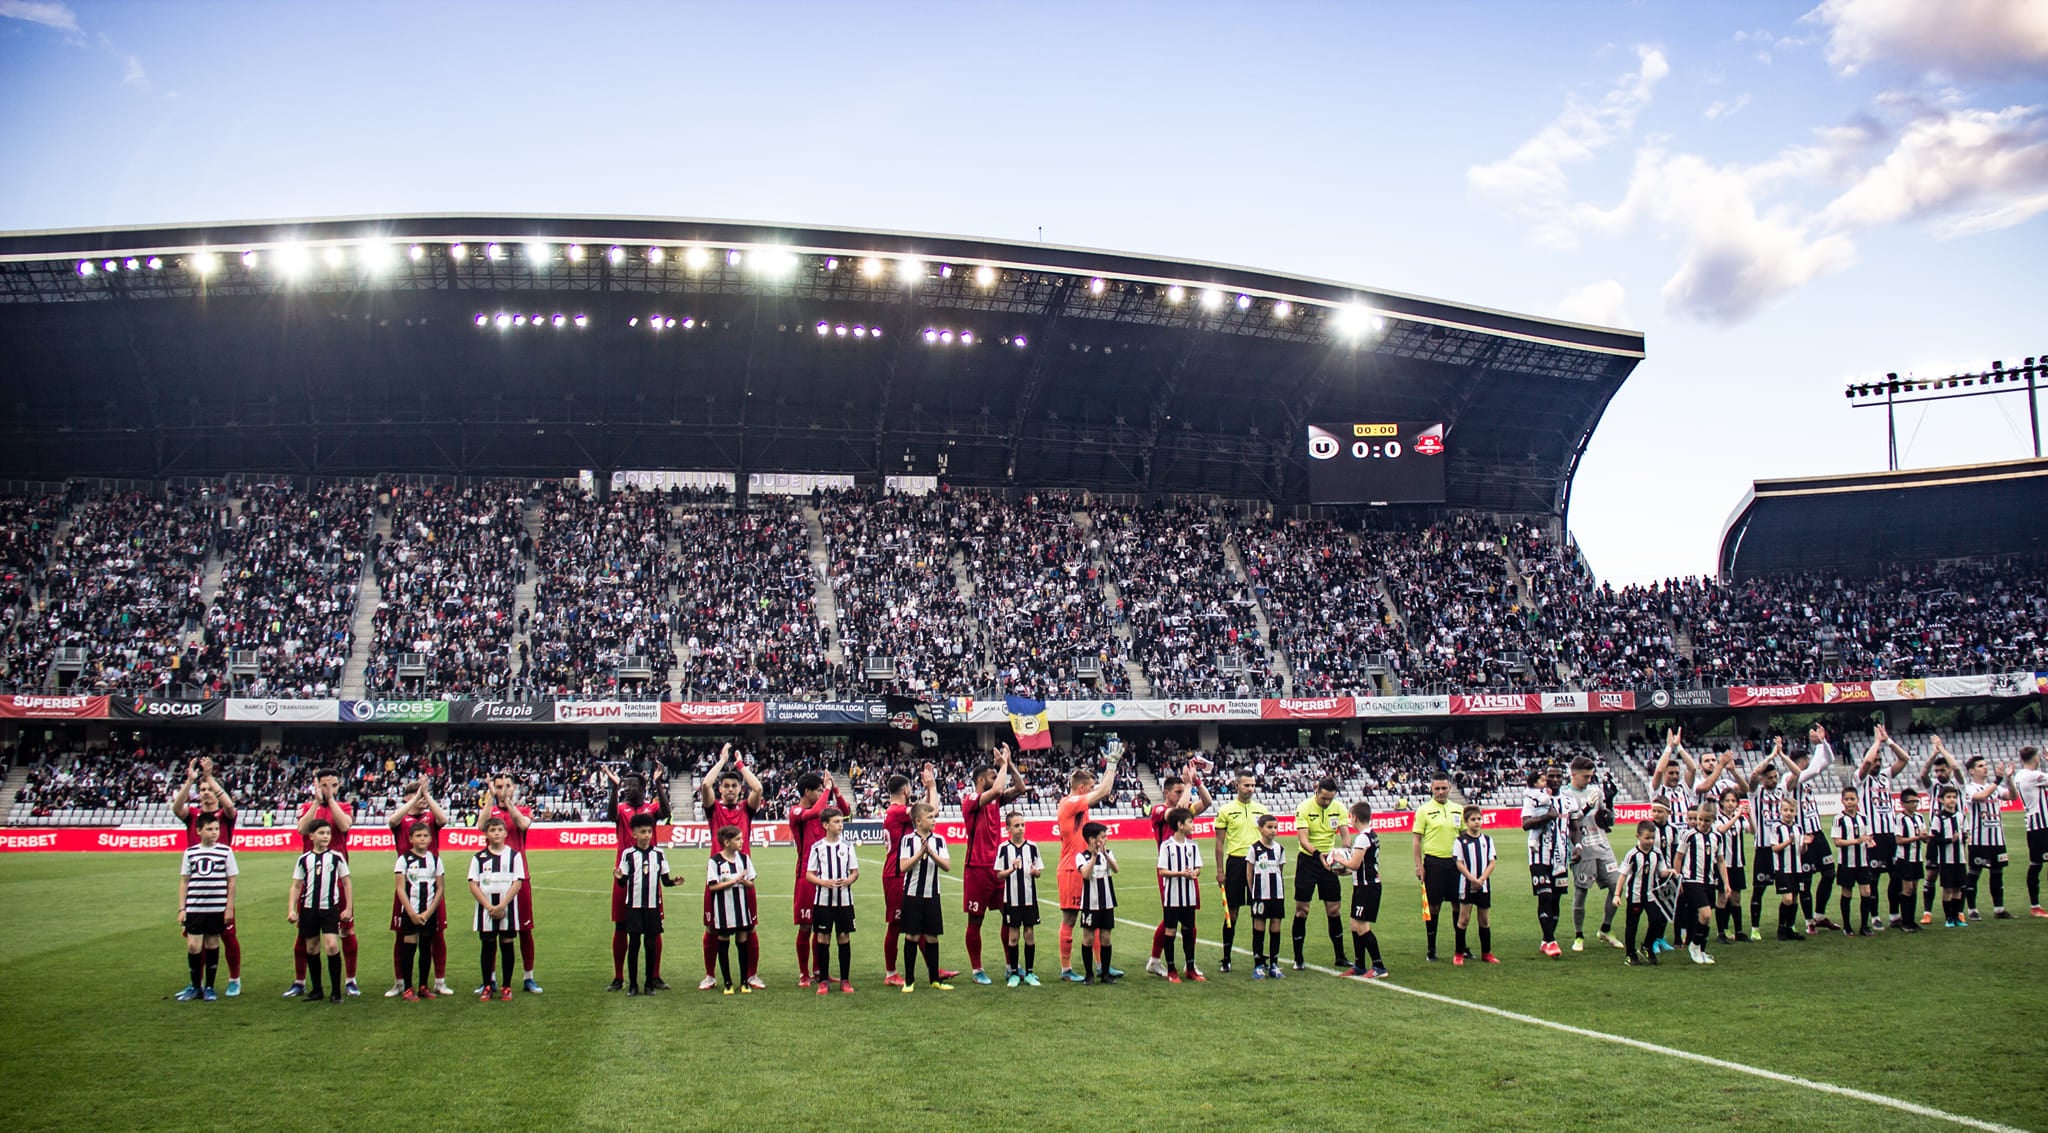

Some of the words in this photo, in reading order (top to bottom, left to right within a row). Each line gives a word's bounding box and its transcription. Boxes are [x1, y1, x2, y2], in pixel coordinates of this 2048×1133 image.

[1315, 442, 1330, 454] U
[1352, 441, 1402, 458] 0:0
[613, 471, 732, 485] CONSILIUL
[886, 476, 935, 489] CLUJ
[1746, 684, 1806, 698] SUPERBET
[13, 694, 89, 709] SUPERBET
[1279, 698, 1338, 711] SUPERBET
[1461, 694, 1528, 708] TARSIN
[1554, 695, 1576, 704] PMA
[1600, 694, 1622, 703] PMA
[148, 702, 202, 715] SOCAR
[375, 702, 434, 713] AROBS
[485, 699, 533, 718] Terapia
[624, 703, 657, 711] Tractoare
[680, 702, 745, 716] SUPERBET
[846, 704, 865, 712] LOCAL
[1357, 703, 1371, 711] ECO
[1404, 701, 1448, 709] CONSTRUCT
[1369, 815, 1409, 830] ERBET
[0, 833, 58, 848] PERBET
[98, 833, 178, 848] SUPERBET
[231, 833, 293, 848] PERBET
[346, 834, 396, 847] PERB
[448, 832, 487, 847] SUPE
[560, 831, 618, 846] SUPERB
[671, 825, 778, 842] SUPET
[860, 829, 884, 841] CLUJ
[199, 858, 213, 875] U
[968, 900, 980, 913] 23
[1072, 894, 1082, 906] 12
[800, 908, 811, 920] 14
[1081, 912, 1093, 926] 14
